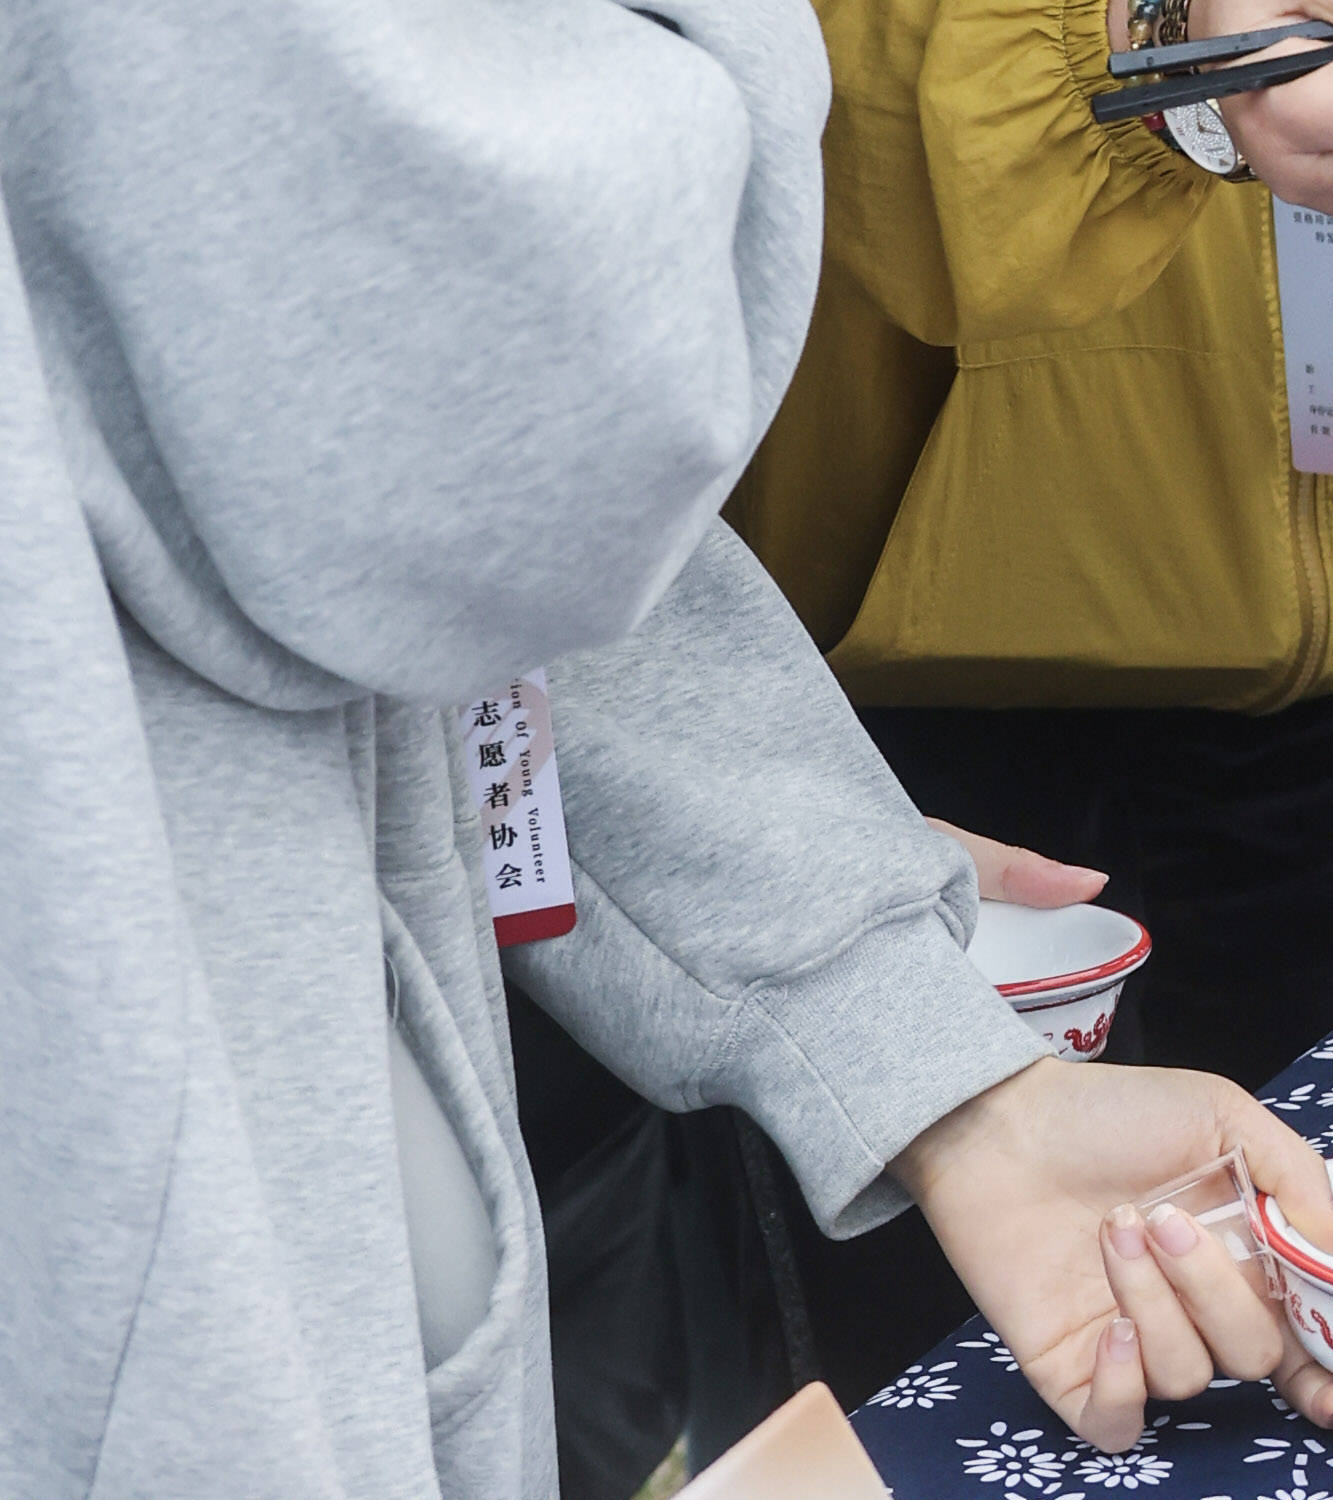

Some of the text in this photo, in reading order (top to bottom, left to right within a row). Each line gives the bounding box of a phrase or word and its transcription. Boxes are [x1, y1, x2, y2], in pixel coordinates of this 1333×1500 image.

[471, 700, 522, 890] 志愿者协会
[520, 748, 534, 798] Young
[528, 807, 546, 884] Volunteer
